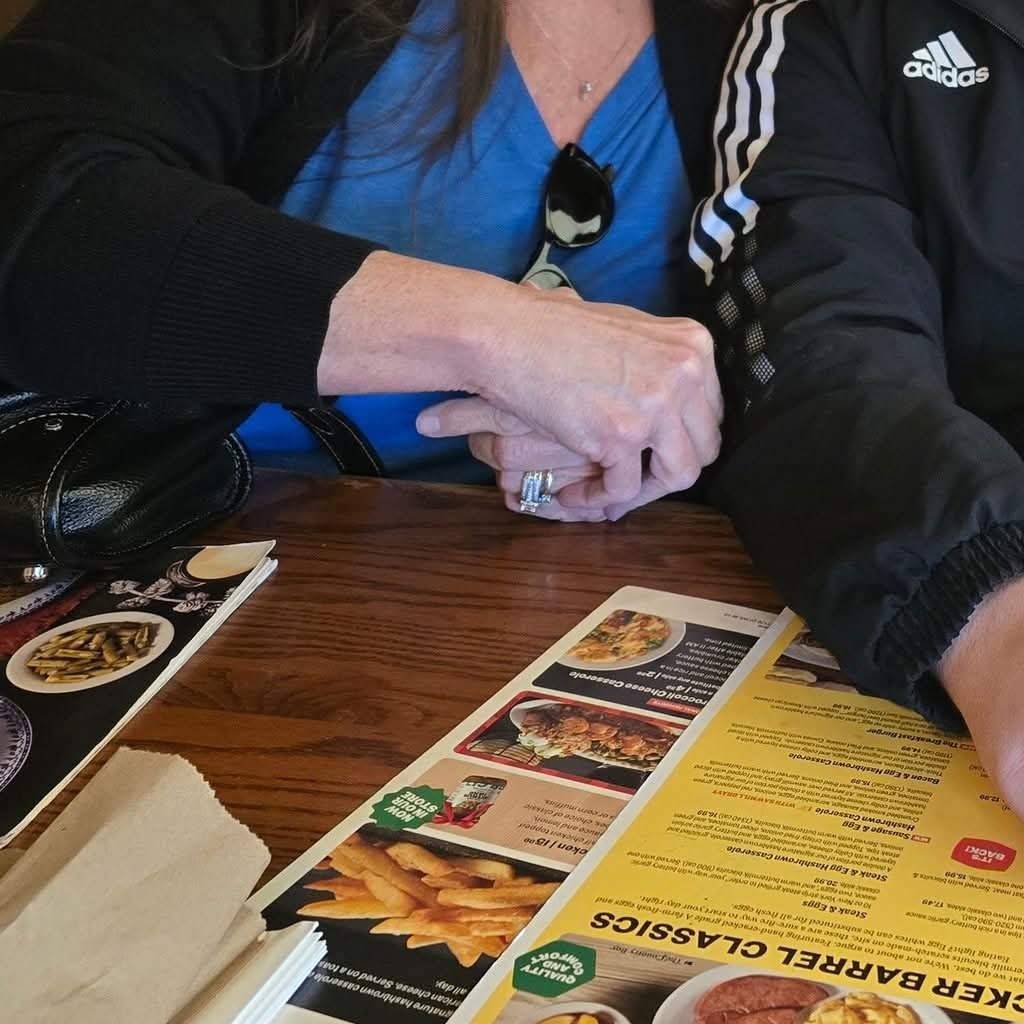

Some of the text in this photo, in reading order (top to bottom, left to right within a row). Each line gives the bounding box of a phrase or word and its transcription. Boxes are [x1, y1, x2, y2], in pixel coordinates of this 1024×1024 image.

[903, 61, 990, 88] adidas
[569, 671, 708, 705] roccoli Cheese Casserole
[866, 728, 958, 748] The Breakfast Burger
[788, 753, 832, 766] Casserole
[832, 761, 883, 775] Hashbrown
[883, 769, 902, 778] Egg
[911, 774, 940, 785] Bacon
[393, 791, 438, 813] STORE
[979, 794, 1000, 803] 12.99
[389, 796, 431, 819] IN OUR
[384, 805, 421, 822] NOW
[815, 807, 915, 832] Hashbrown Casserole
[842, 820, 861, 830] Egg
[870, 827, 911, 840] Sausage
[726, 846, 774, 860] Casserole
[964, 845, 1005, 861] BACK!
[971, 854, 993, 863] IT'S
[774, 855, 829, 871] Hashbrown
[829, 864, 850, 875] Egg
[859, 871, 888, 882] Steak
[813, 878, 838, 887] 20.99
[594, 896, 614, 904] and
[614, 900, 635, 908] eggs
[639, 896, 664, 905] right.
[664, 900, 682, 909] day
[922, 899, 944, 908] 17.49
[636, 904, 684, 919] farm-fresh
[683, 904, 705, 912] your
[704, 908, 727, 916] start
[731, 904, 754, 912] eggs.
[755, 908, 779, 918] fresh
[802, 900, 868, 919] Steak & Eggs
[694, 915, 722, 924] grade
[739, 914, 758, 923] way
[759, 918, 799, 930] sure-fire
[793, 916, 808, 924] for
[721, 920, 785, 938] hand-cracked
[808, 919, 862, 933] substituted
[591, 912, 767, 958] CLASSICS
[824, 930, 849, 940] these
[863, 929, 875, 937] be
[785, 931, 831, 947] Featuring
[851, 935, 871, 944] site,
[895, 935, 925, 945] whites
[834, 942, 863, 951] argue.
[886, 942, 950, 959] scratch-made
[927, 940, 947, 951] Egg
[947, 945, 976, 957] light?
[876, 950, 904, 960] about
[905, 955, 923, 963] not
[977, 950, 1010, 963] Eating
[530, 951, 584, 975] COMFORT
[542, 960, 570, 972] AND
[924, 959, 950, 970] We're
[952, 956, 989, 968] biscuits
[346, 969, 360, 977] on
[520, 964, 576, 984] QUALITY
[778, 946, 926, 991] BARREL
[954, 965, 977, 976] best.
[978, 970, 992, 978] do
[357, 973, 394, 989] Served
[312, 973, 414, 1008] hashbrown casserole
[395, 982, 431, 998] cheese.
[435, 980, 467, 995] all day.
